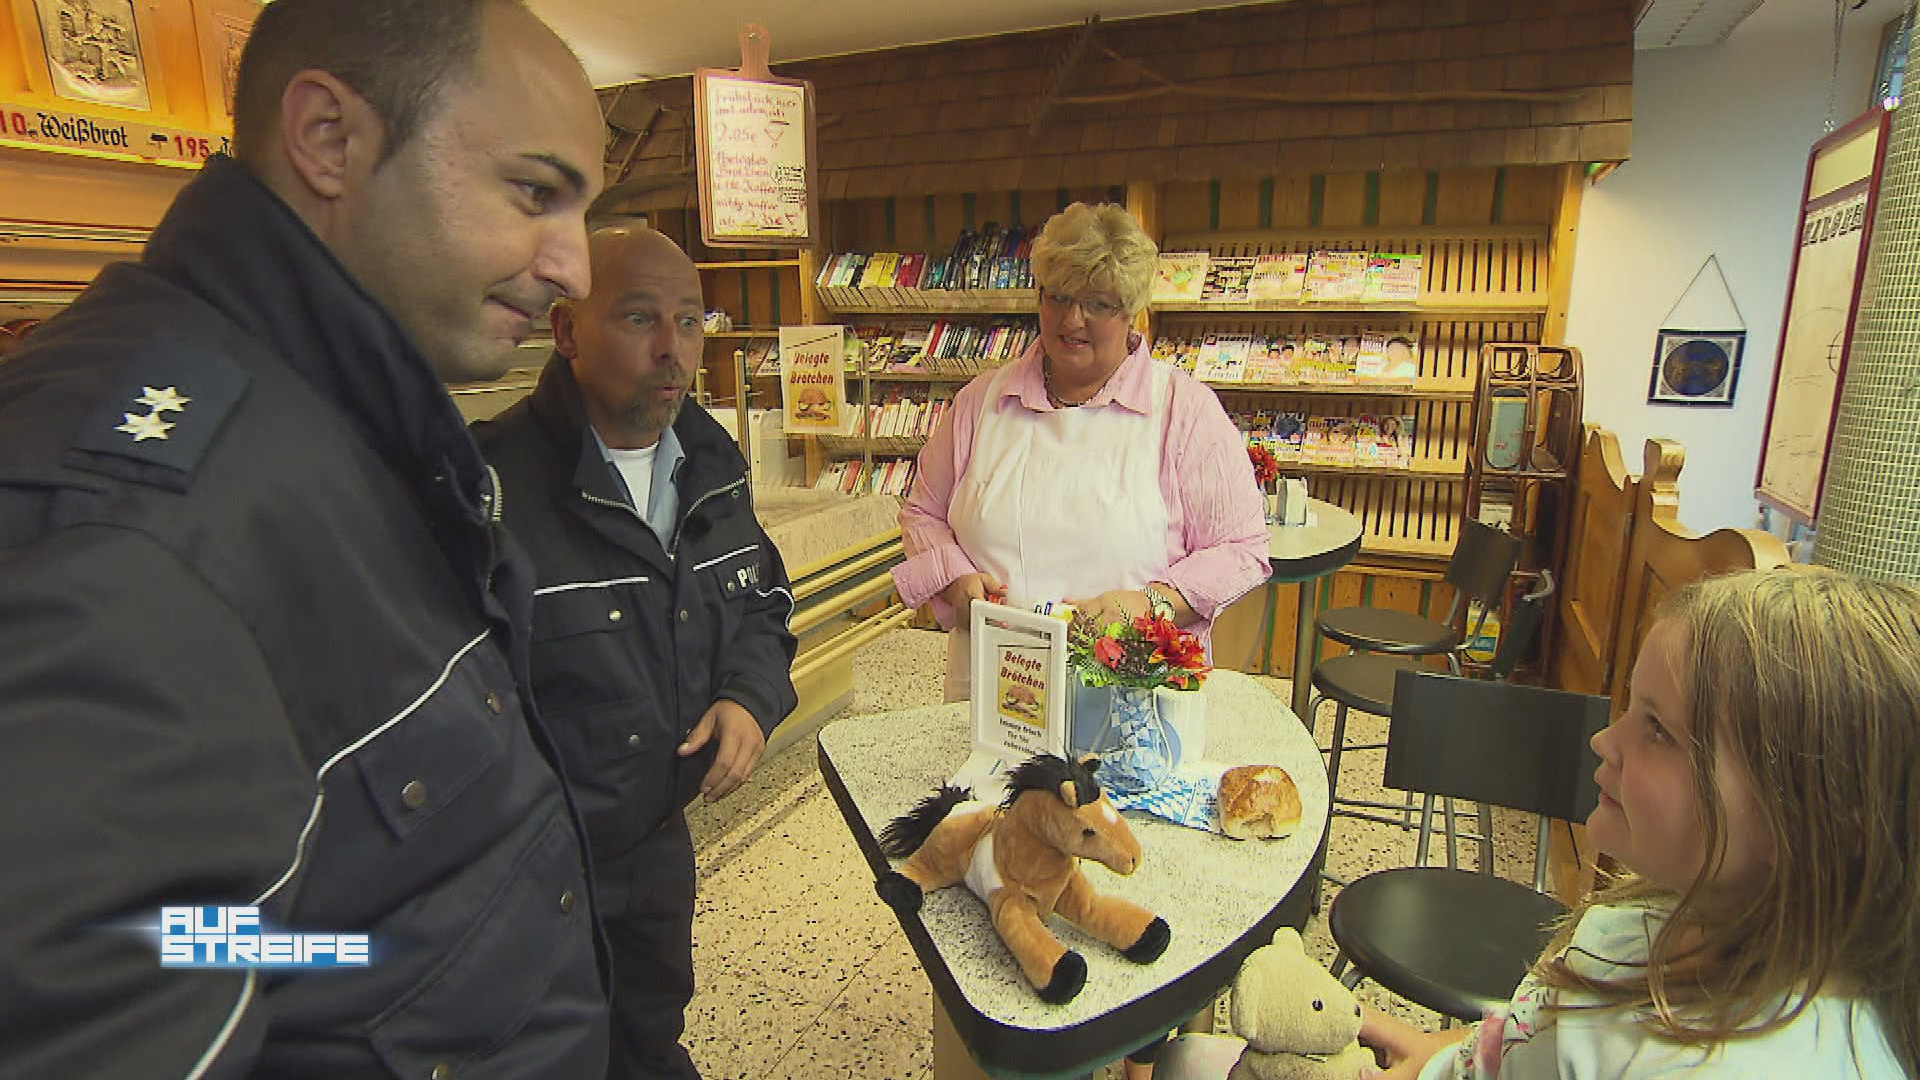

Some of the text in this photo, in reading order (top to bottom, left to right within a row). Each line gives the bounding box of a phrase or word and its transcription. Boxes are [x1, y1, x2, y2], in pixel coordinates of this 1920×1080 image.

[36, 112, 129, 147] Weißbrot
[174, 134, 209, 158] 195
[790, 370, 834, 386] Brötchen
[1004, 650, 1042, 672] Belegte
[1001, 667, 1045, 690] Brötchen
